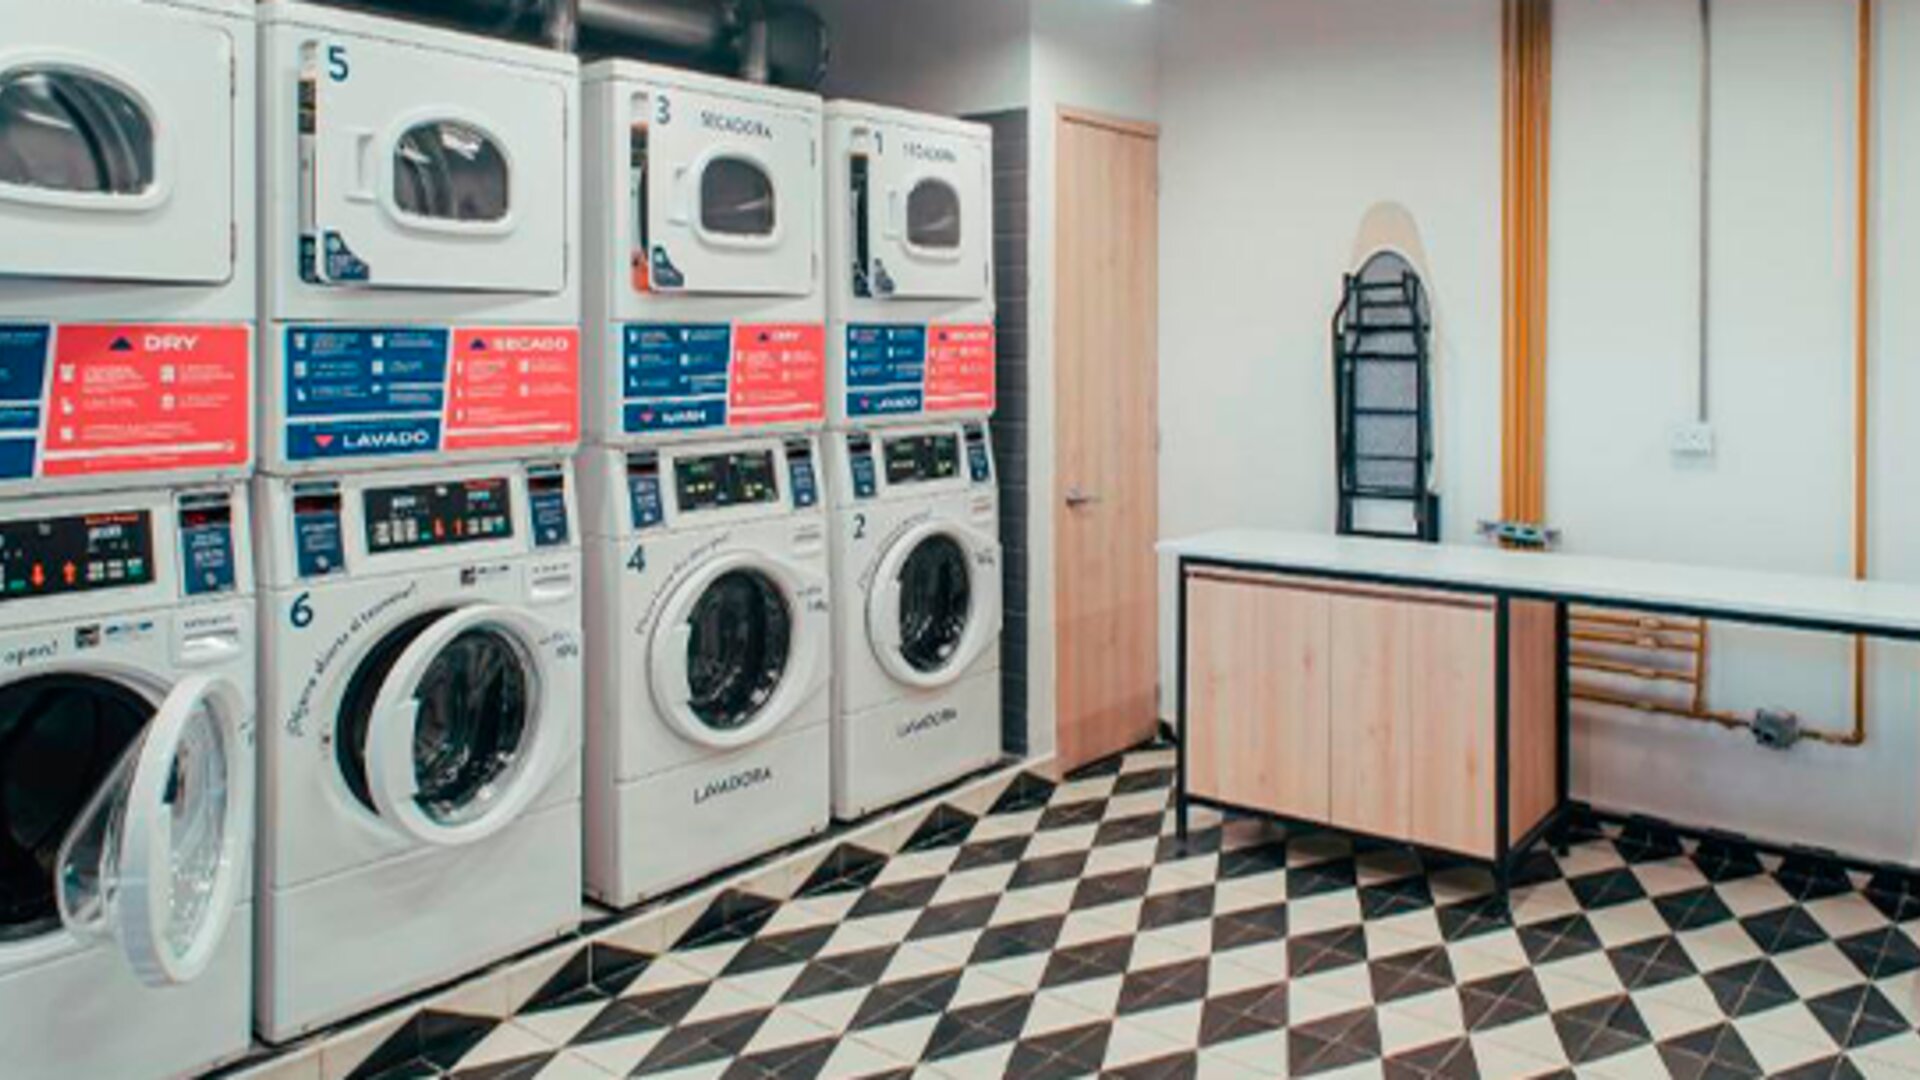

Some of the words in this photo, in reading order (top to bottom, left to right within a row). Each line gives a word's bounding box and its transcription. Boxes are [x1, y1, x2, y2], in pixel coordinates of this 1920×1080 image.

[328, 46, 349, 82] 5
[656, 96, 670, 125] 3
[874, 131, 883, 154] 1
[144, 334, 198, 351] DRY
[491, 337, 569, 350] SECADO
[342, 430, 429, 448] LAVADO
[853, 513, 866, 539] 2
[626, 545, 645, 573] 4
[290, 592, 314, 628] 6
[694, 767, 773, 805] LAVADORA
